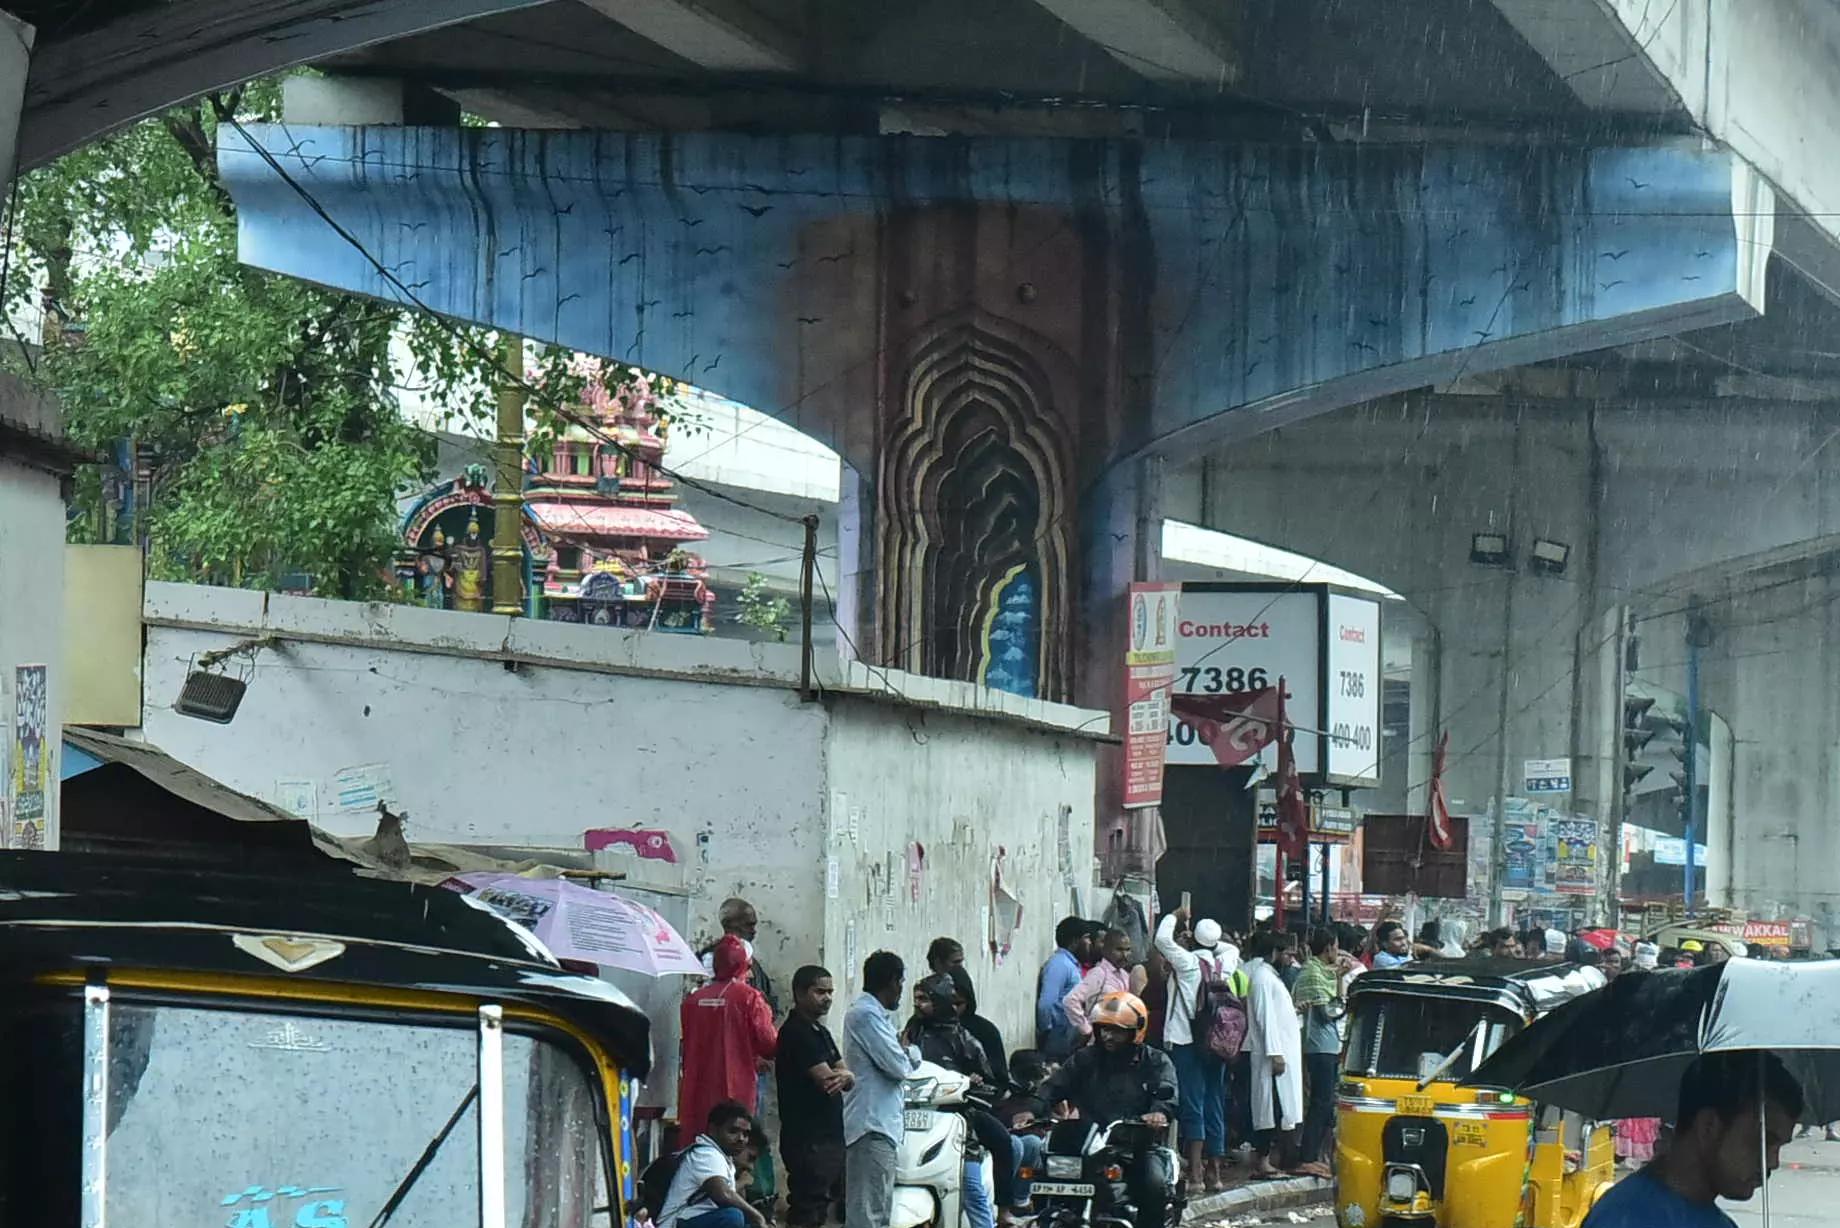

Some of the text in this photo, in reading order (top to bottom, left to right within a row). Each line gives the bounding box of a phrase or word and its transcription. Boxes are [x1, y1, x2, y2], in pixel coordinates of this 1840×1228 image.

[1179, 621, 1270, 639] Contact
[1340, 624, 1366, 645] Contact
[1181, 667, 1268, 694] 7386
[1340, 671, 1365, 699] 7386
[1333, 722, 1372, 752] 400-400
